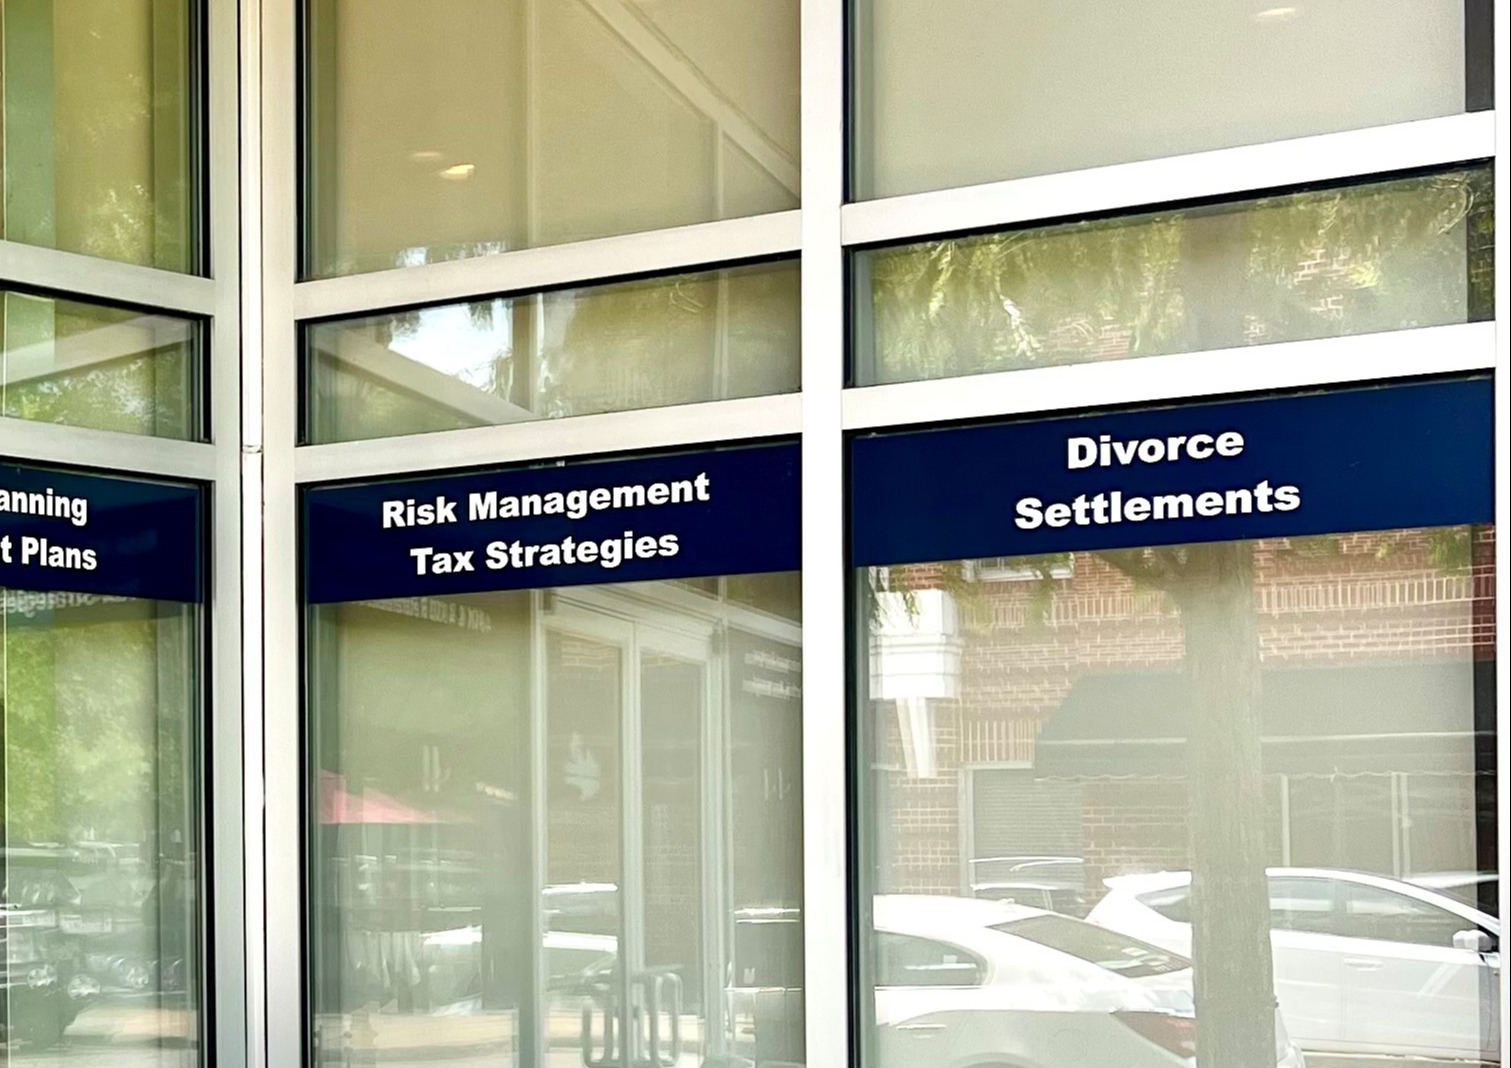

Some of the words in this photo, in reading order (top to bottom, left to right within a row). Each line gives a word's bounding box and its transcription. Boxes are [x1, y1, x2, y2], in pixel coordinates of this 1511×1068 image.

[1068, 431, 1244, 469] Divorce
[382, 496, 457, 528] Risk
[468, 472, 710, 521] Management
[1014, 479, 1300, 529] Settlements
[21, 535, 97, 570] Plans
[409, 547, 475, 575] Tax
[485, 530, 679, 569] Strategies
